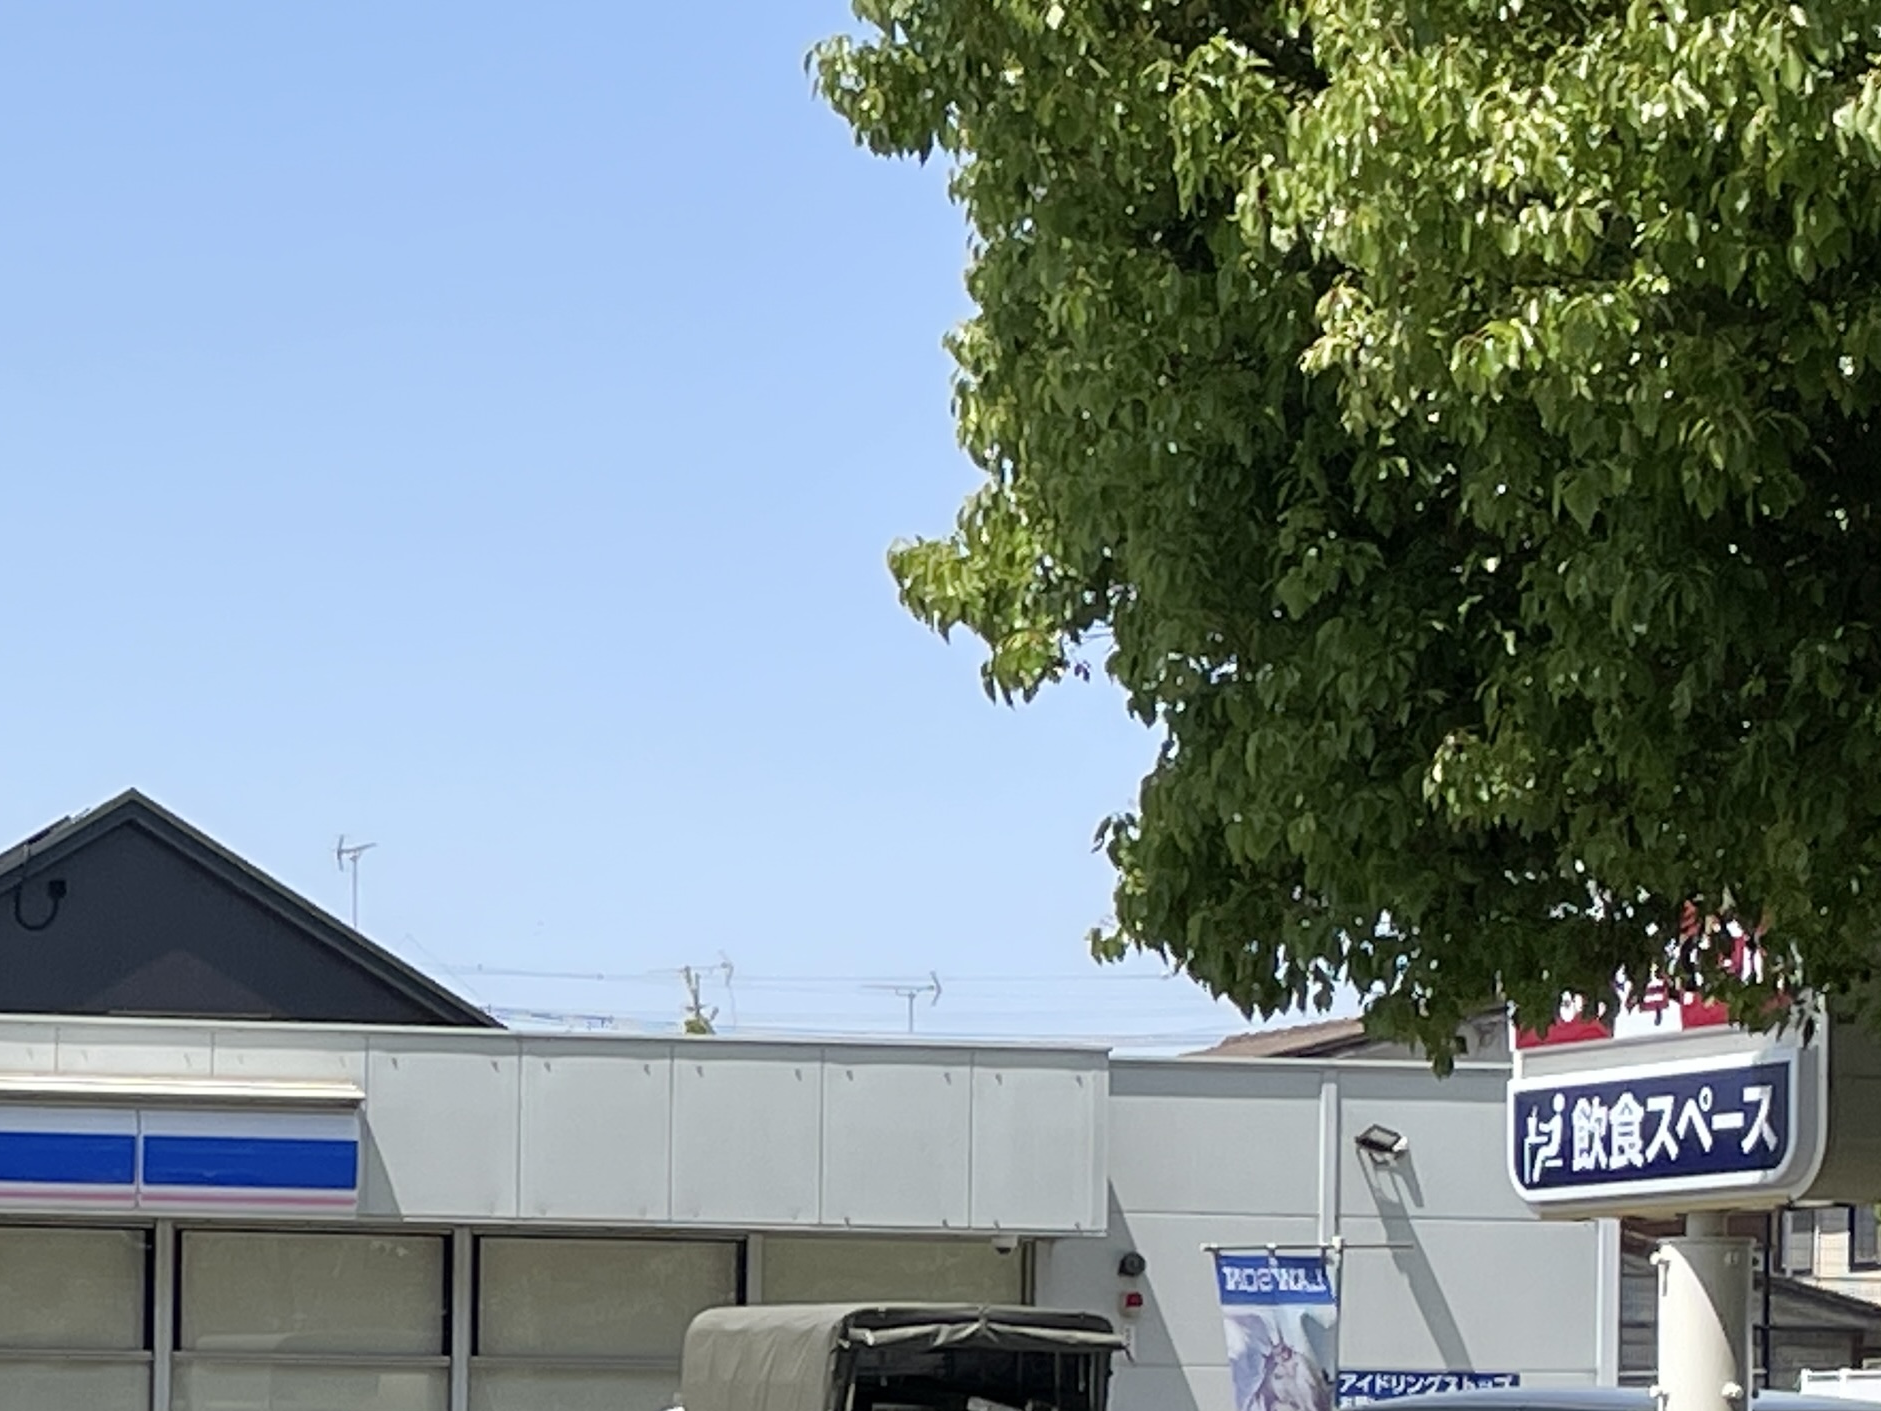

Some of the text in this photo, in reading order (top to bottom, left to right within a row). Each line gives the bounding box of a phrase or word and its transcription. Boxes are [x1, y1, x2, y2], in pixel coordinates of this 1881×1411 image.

[1572, 1086, 1778, 1171] 飲食スペース
